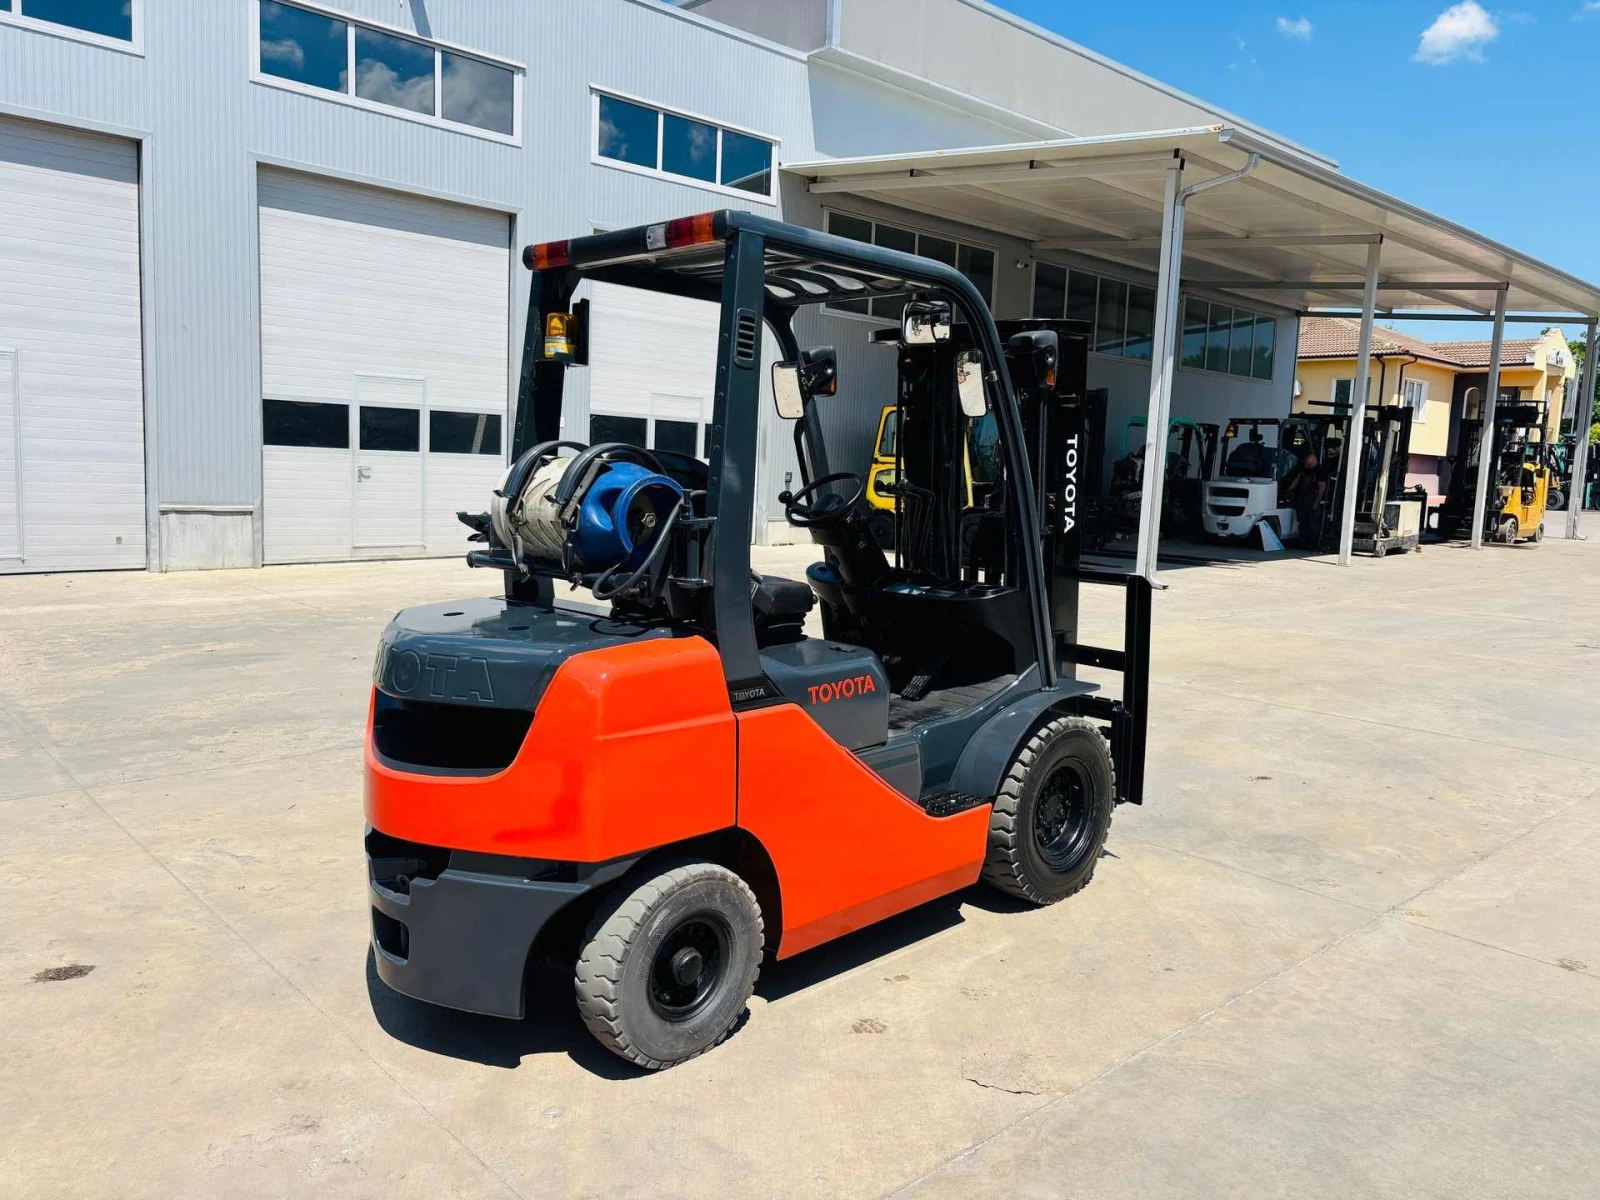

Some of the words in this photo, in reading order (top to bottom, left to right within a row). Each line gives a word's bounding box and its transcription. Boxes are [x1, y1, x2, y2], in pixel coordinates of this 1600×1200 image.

[1064, 433, 1078, 534] TOYOTA
[733, 688, 766, 701] TOYOTA
[807, 675, 876, 705] TOYOTA
